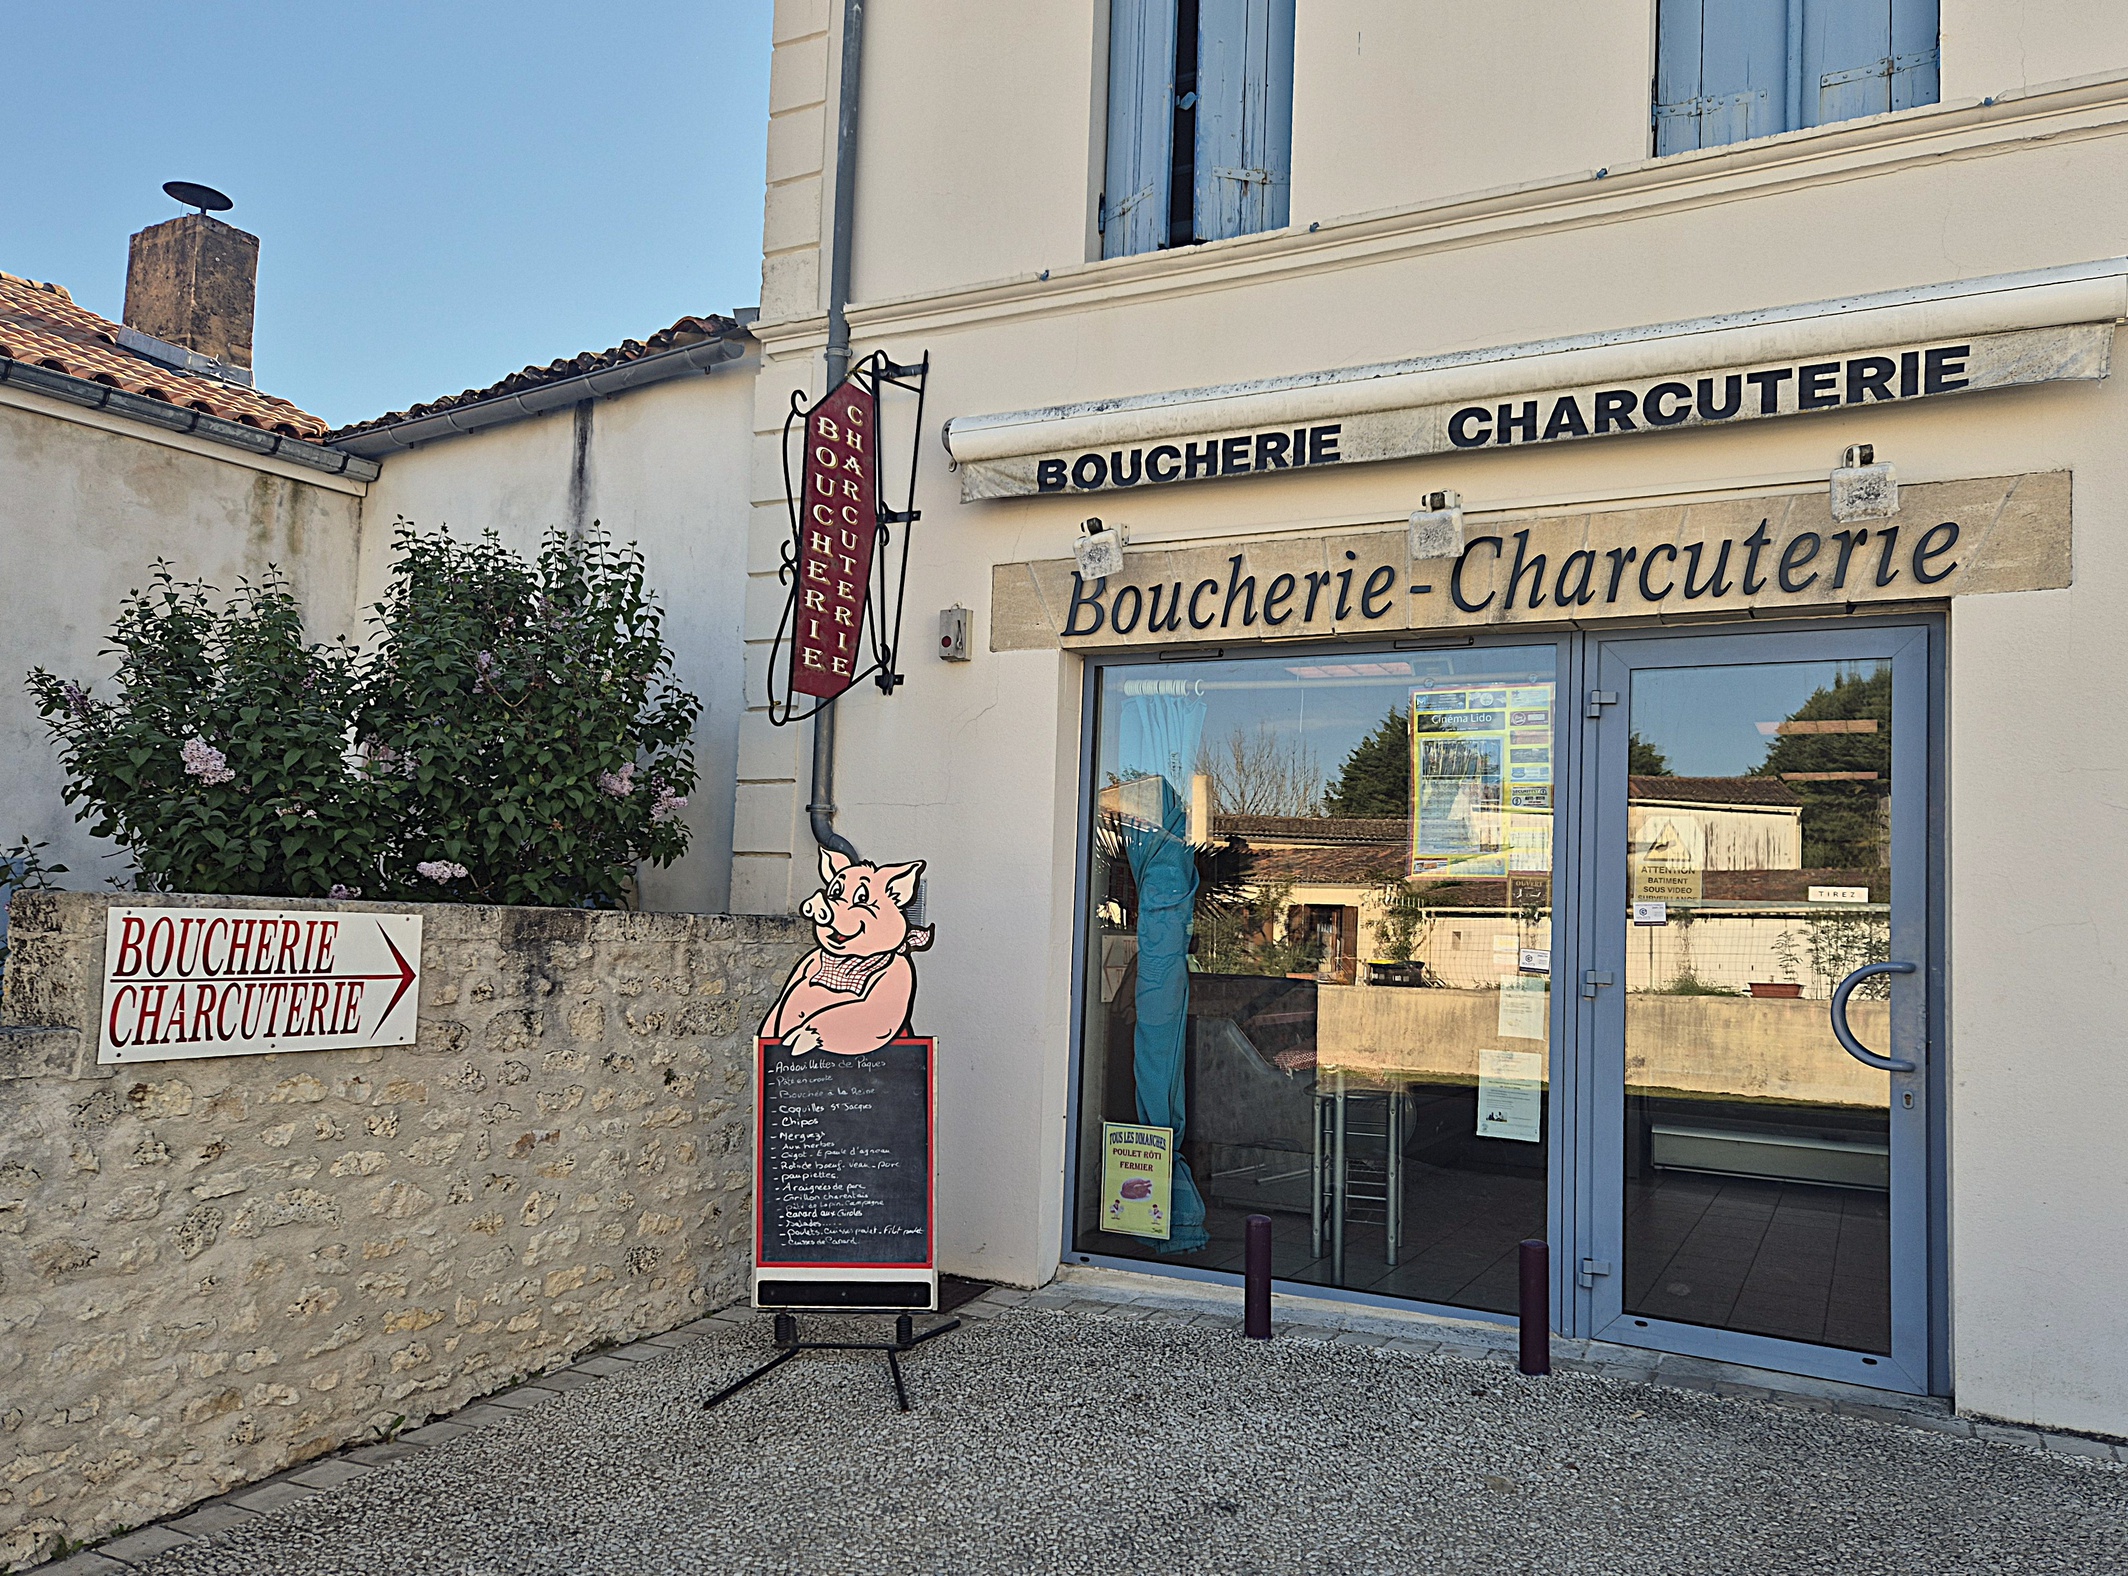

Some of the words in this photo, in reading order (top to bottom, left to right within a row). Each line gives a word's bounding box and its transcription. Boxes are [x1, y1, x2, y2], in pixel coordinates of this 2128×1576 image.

[1037, 424, 1342, 493] BOUCHERIE
[1447, 345, 1970, 448] CHARCUTERIE
[802, 416, 840, 671] BOUCHERIE
[831, 405, 863, 678] CHARCUTERIE
[1431, 713, 1468, 724] Cinéma
[1470, 713, 1492, 723] Lido
[1641, 866, 1696, 875] ATTENTION
[1648, 877, 1688, 885] BATIMENT
[1643, 886, 1665, 894] SOUS
[1818, 890, 1857, 899] TIREZ
[112, 916, 339, 978] BOUCHERIE
[109, 981, 365, 1048] CHARCUTERIE
[838, 1060, 853, 1068] de
[779, 1103, 825, 1117] Coquilles
[1109, 1131, 1123, 1145] TOUS
[1123, 1131, 1134, 1144] LES
[1135, 1132, 1166, 1150] DIMANCHES
[1112, 1147, 1142, 1157] POULET
[1119, 1161, 1153, 1172] FERMIER
